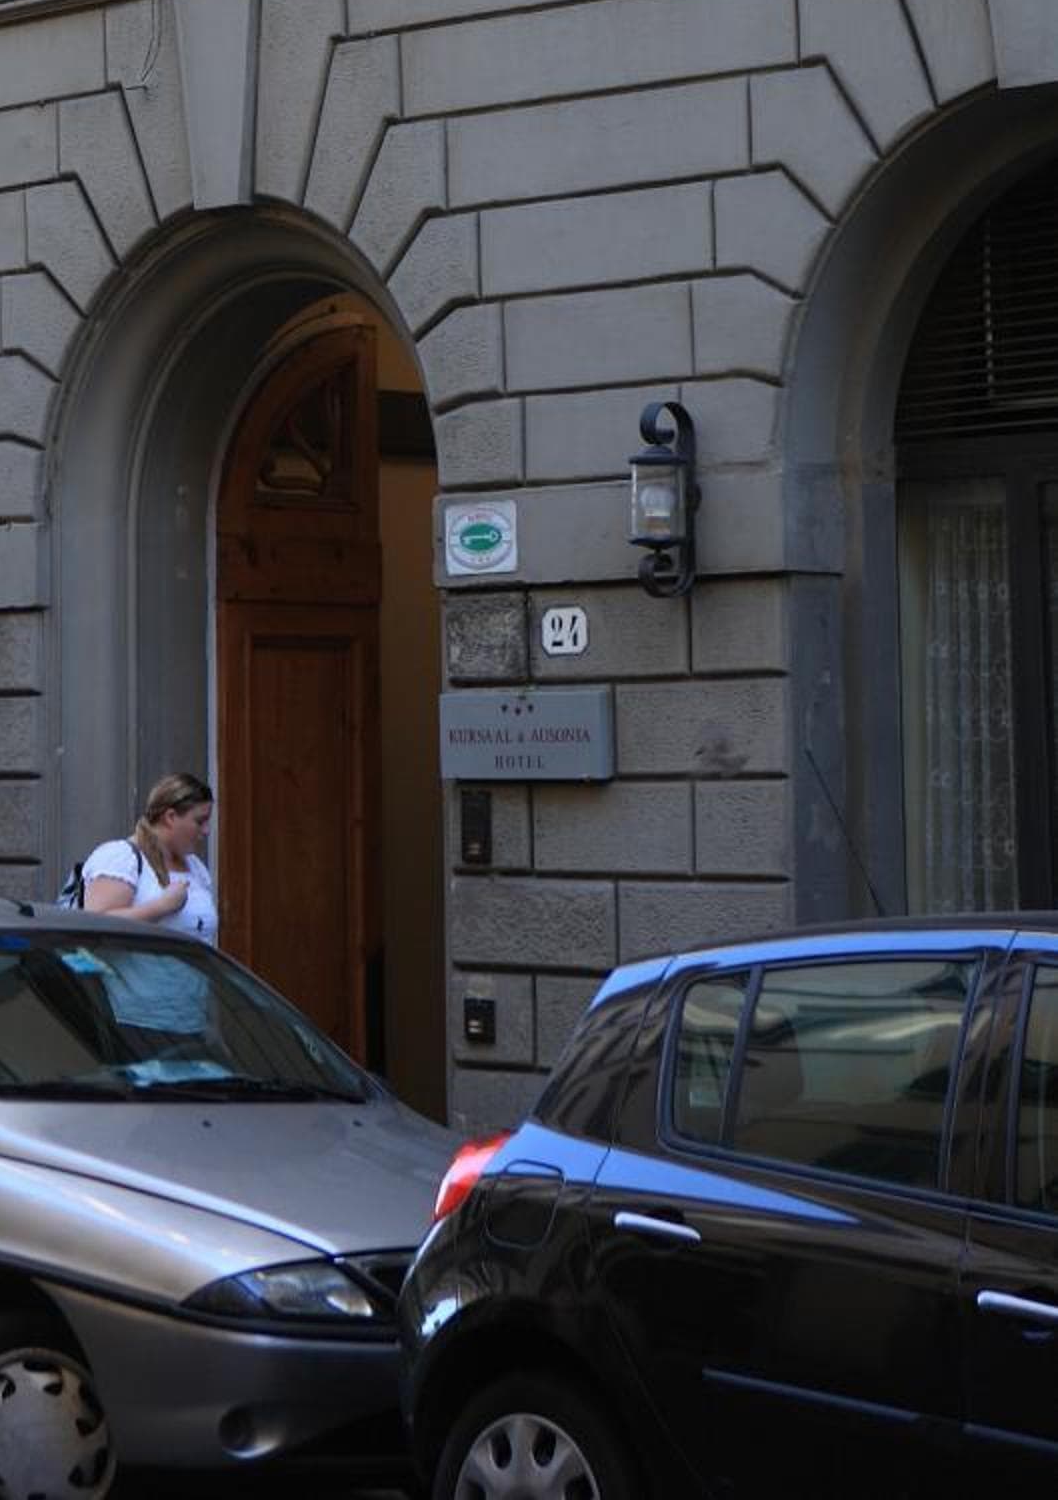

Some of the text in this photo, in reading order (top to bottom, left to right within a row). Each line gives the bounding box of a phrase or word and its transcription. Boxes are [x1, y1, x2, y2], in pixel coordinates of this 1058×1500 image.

[551, 615, 579, 647] 24
[449, 728, 512, 744] KURSAAL
[531, 727, 591, 743] AUSONIA
[494, 755, 545, 770] HOTEL
